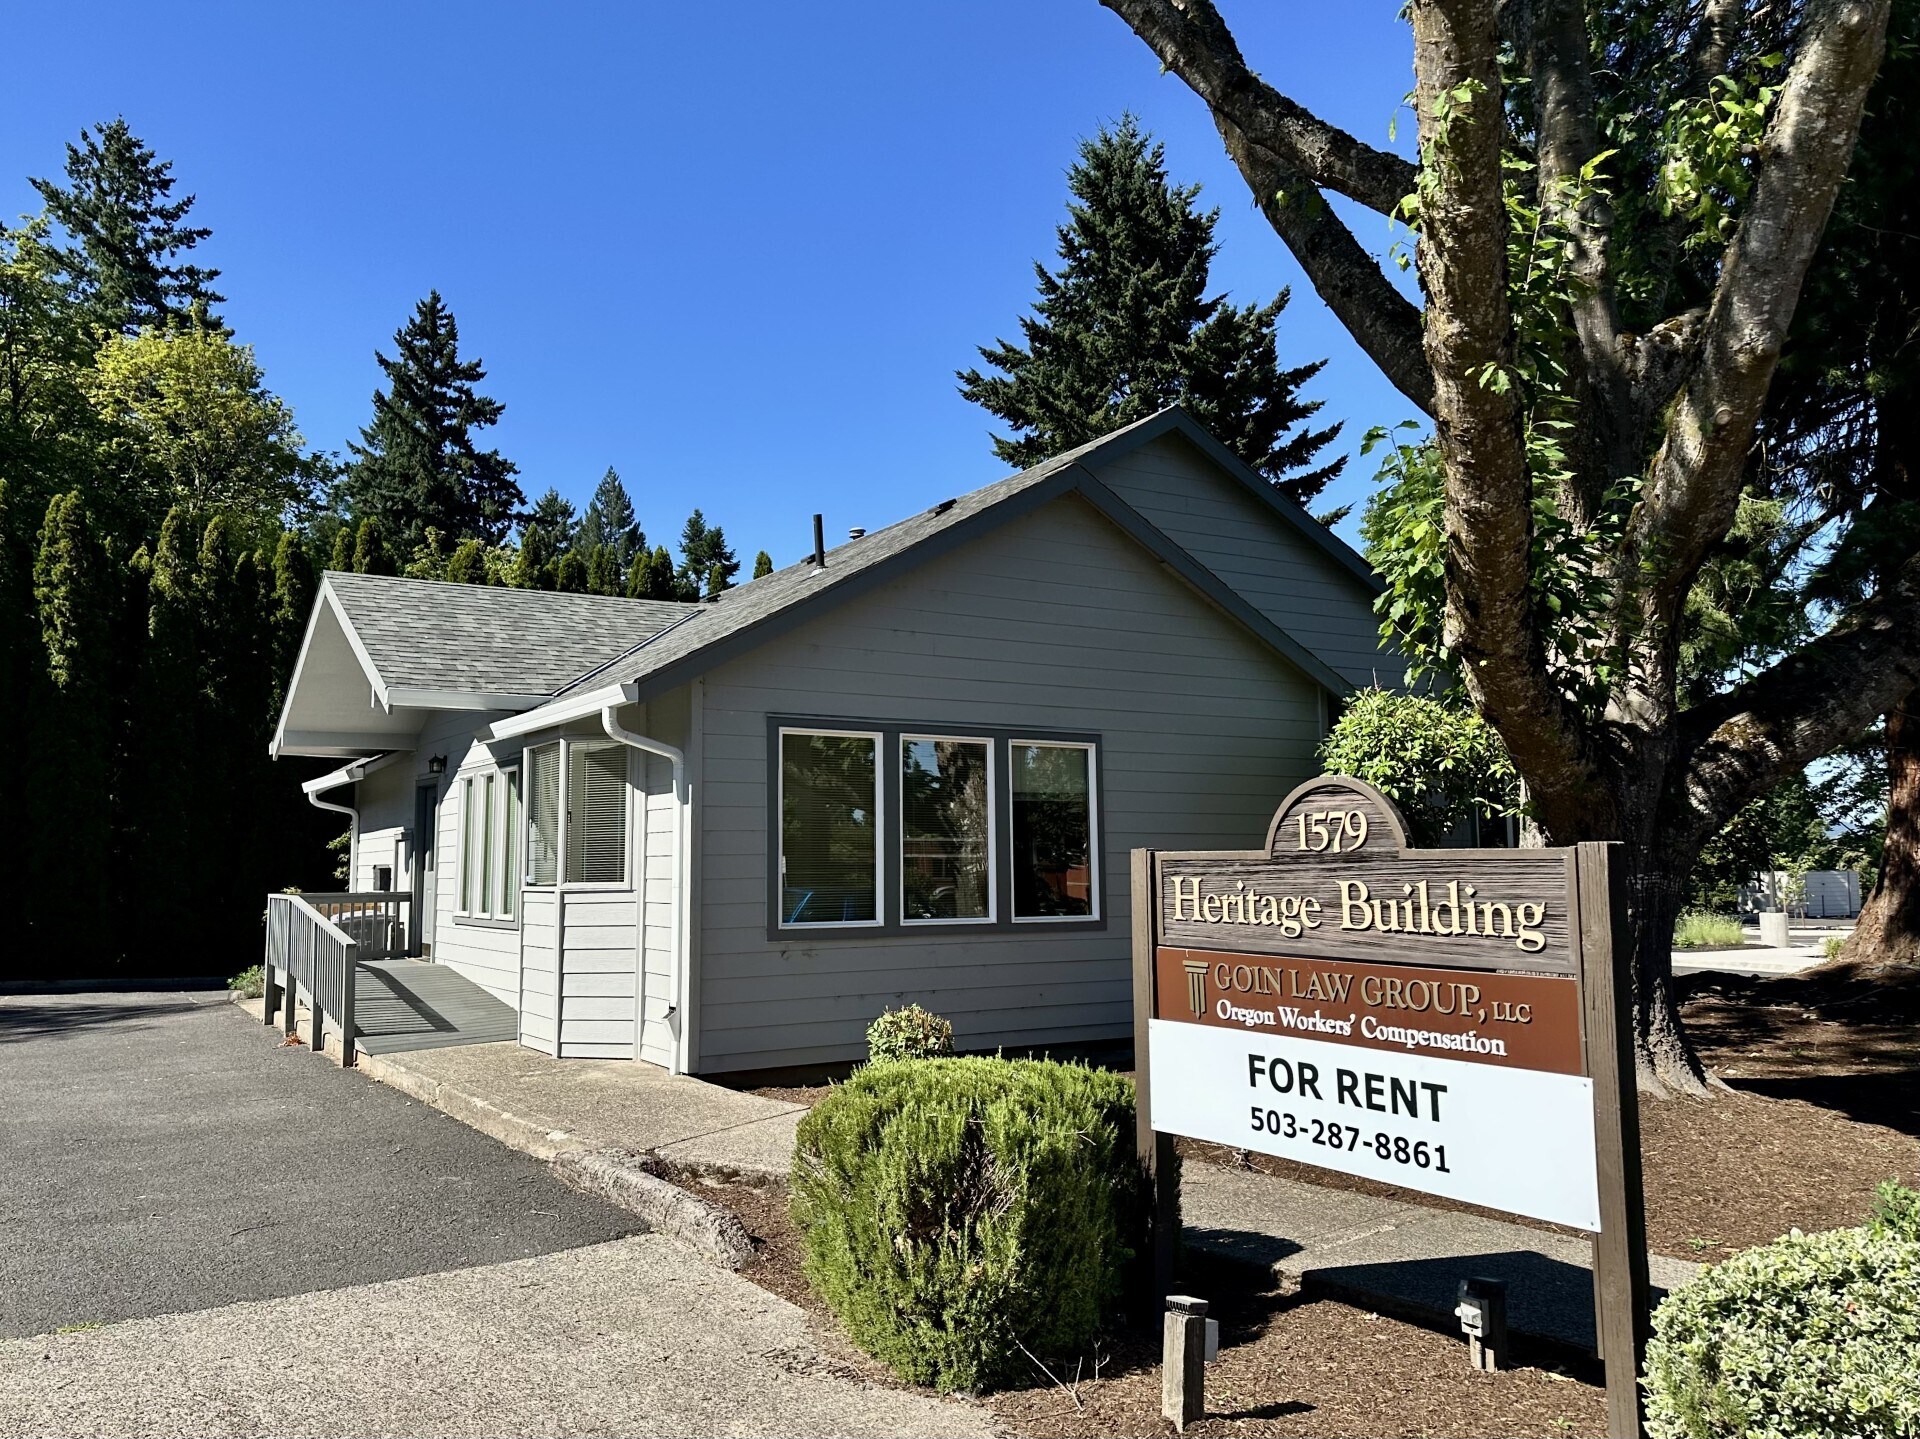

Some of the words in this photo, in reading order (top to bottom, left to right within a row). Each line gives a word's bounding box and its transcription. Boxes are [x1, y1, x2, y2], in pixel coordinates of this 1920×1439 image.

[1295, 810, 1368, 853] 1579
[1171, 876, 1322, 938] Heritage
[1335, 879, 1546, 952] Building
[1214, 963, 1283, 996] GOIN
[1288, 969, 1353, 1003] LAW
[1360, 975, 1488, 1023] GROUP,
[1491, 1001, 1532, 1023] LLC
[1216, 999, 1276, 1027] Oregon
[1360, 1016, 1508, 1056] Compensation
[1248, 1054, 1323, 1100] FOR
[1336, 1068, 1448, 1123] RENT
[1250, 1106, 1450, 1173] 503-287-8861
